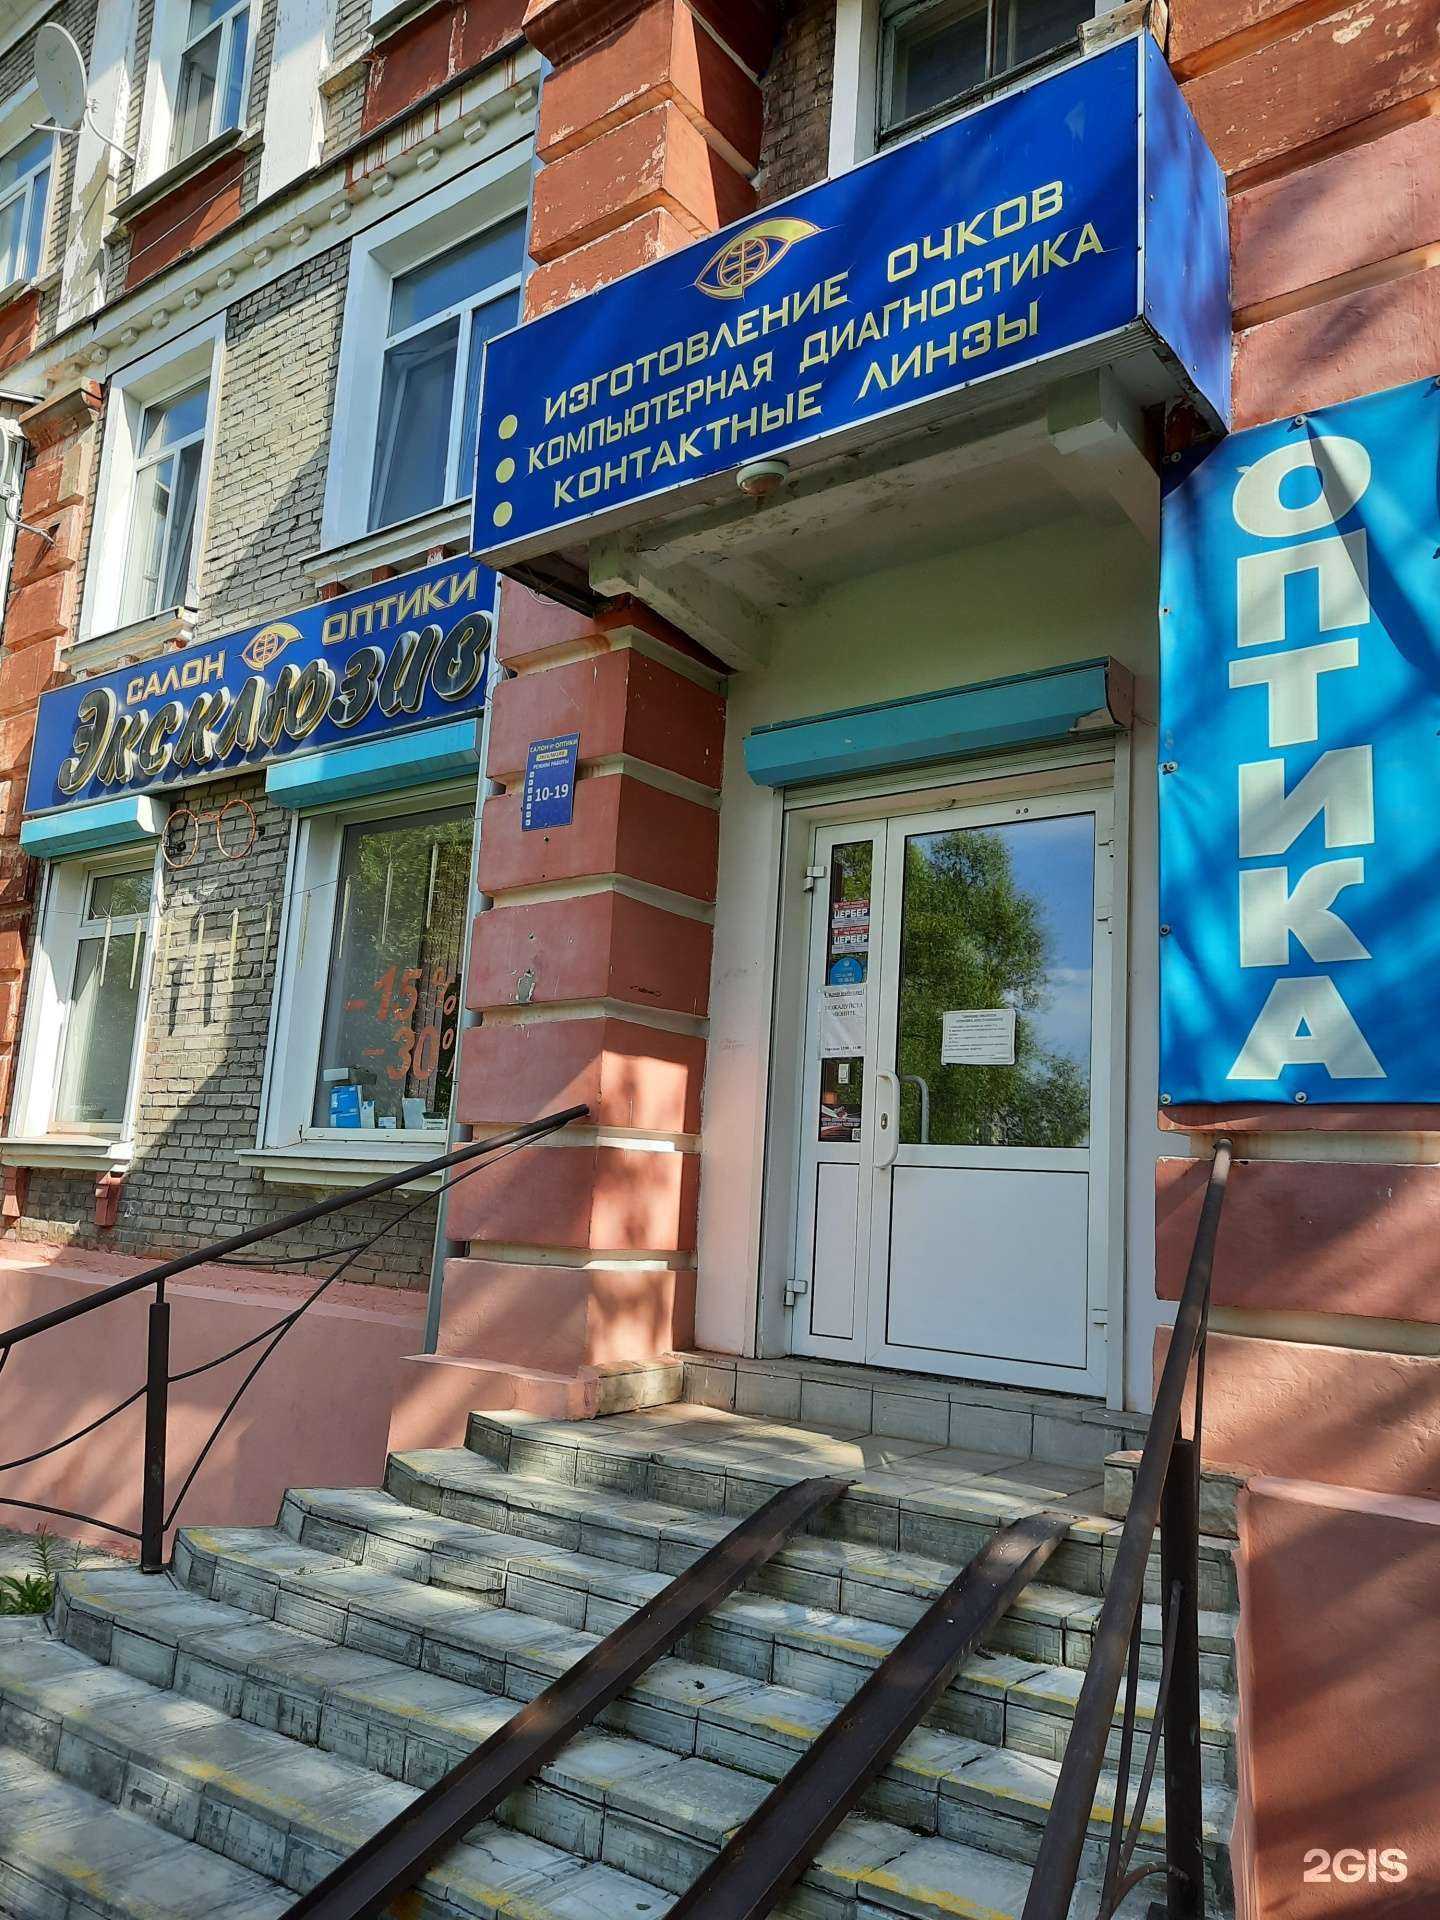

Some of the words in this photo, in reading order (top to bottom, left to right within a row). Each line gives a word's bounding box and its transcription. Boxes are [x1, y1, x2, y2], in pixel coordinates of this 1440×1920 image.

[526, 350, 774, 476] КОМПЬЮТЕРНАЯ
[798, 221, 1105, 376] ДИАГНОСТИКА
[543, 270, 850, 425] ИЗГОТОВЛЕНИЕ
[886, 179, 1065, 283] ОЧКОВ
[552, 382, 823, 509] КОНТАКТНЫЕ
[853, 301, 1040, 400] ЛИНЗЫ
[58, 610, 495, 797] Эксклюзив
[126, 650, 226, 706] САЛОН
[321, 566, 480, 646] ОПТИКИ
[534, 783, 569, 802] 10-19
[1226, 435, 1388, 1079] ОПТИКА
